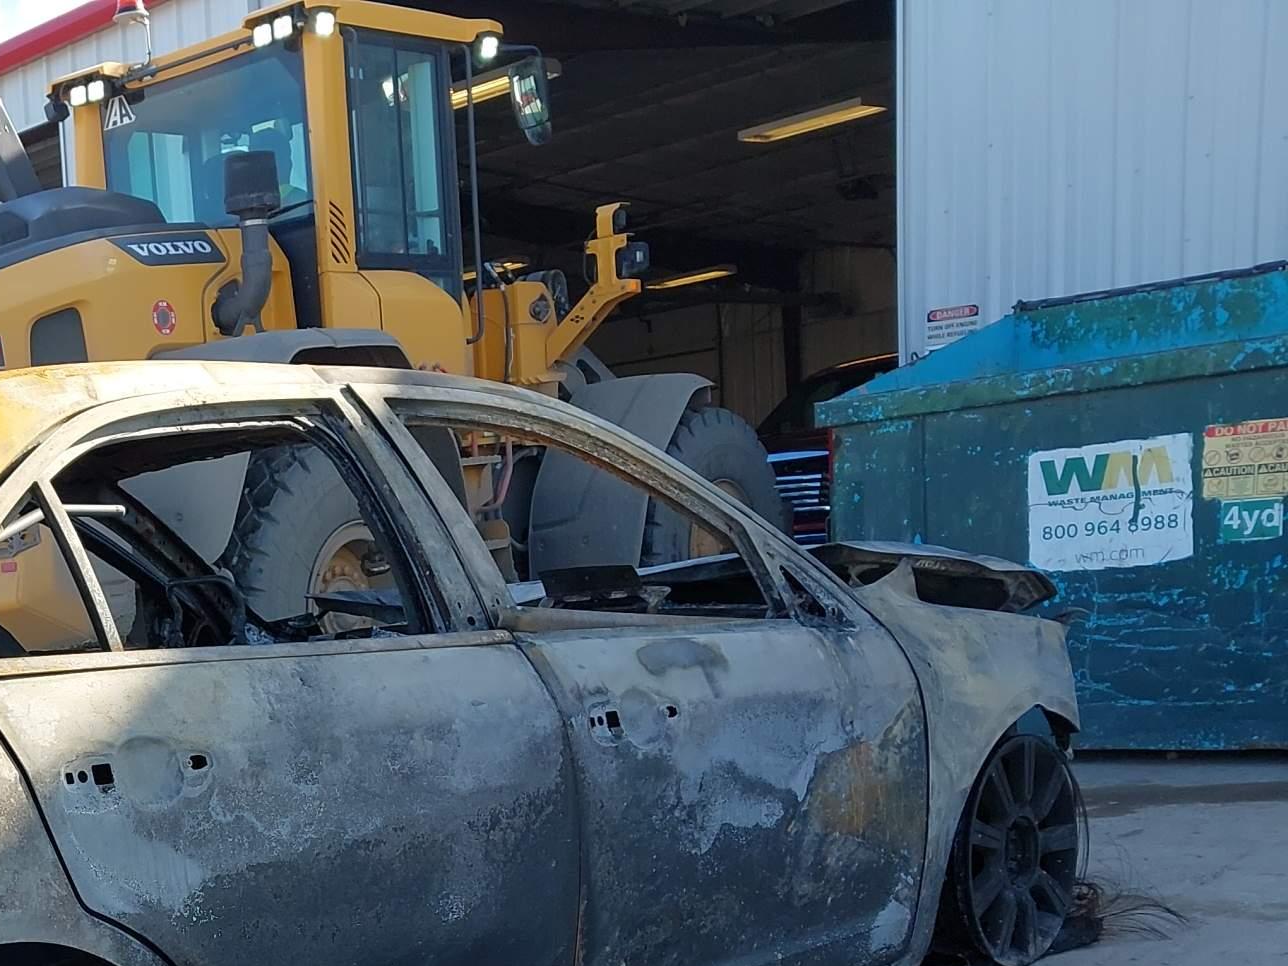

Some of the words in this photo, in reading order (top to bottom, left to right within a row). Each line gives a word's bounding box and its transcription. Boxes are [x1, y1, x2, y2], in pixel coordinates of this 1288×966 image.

[127, 240, 212, 256] VOLVO
[936, 307, 969, 320] DANGER
[1215, 427, 1233, 436] DO
[1238, 422, 1264, 434] NOT
[1268, 420, 1288, 431] PA
[1040, 447, 1174, 496] WM
[1212, 465, 1255, 477] CAUTION
[1048, 496, 1086, 507] WASTE
[1090, 488, 1174, 502] MANAGMENT
[1042, 524, 1079, 540] 800
[1084, 519, 1121, 537] 964
[1127, 513, 1179, 533] 8988
[1223, 502, 1281, 535] 4yd
[1074, 547, 1145, 564] wm.com
